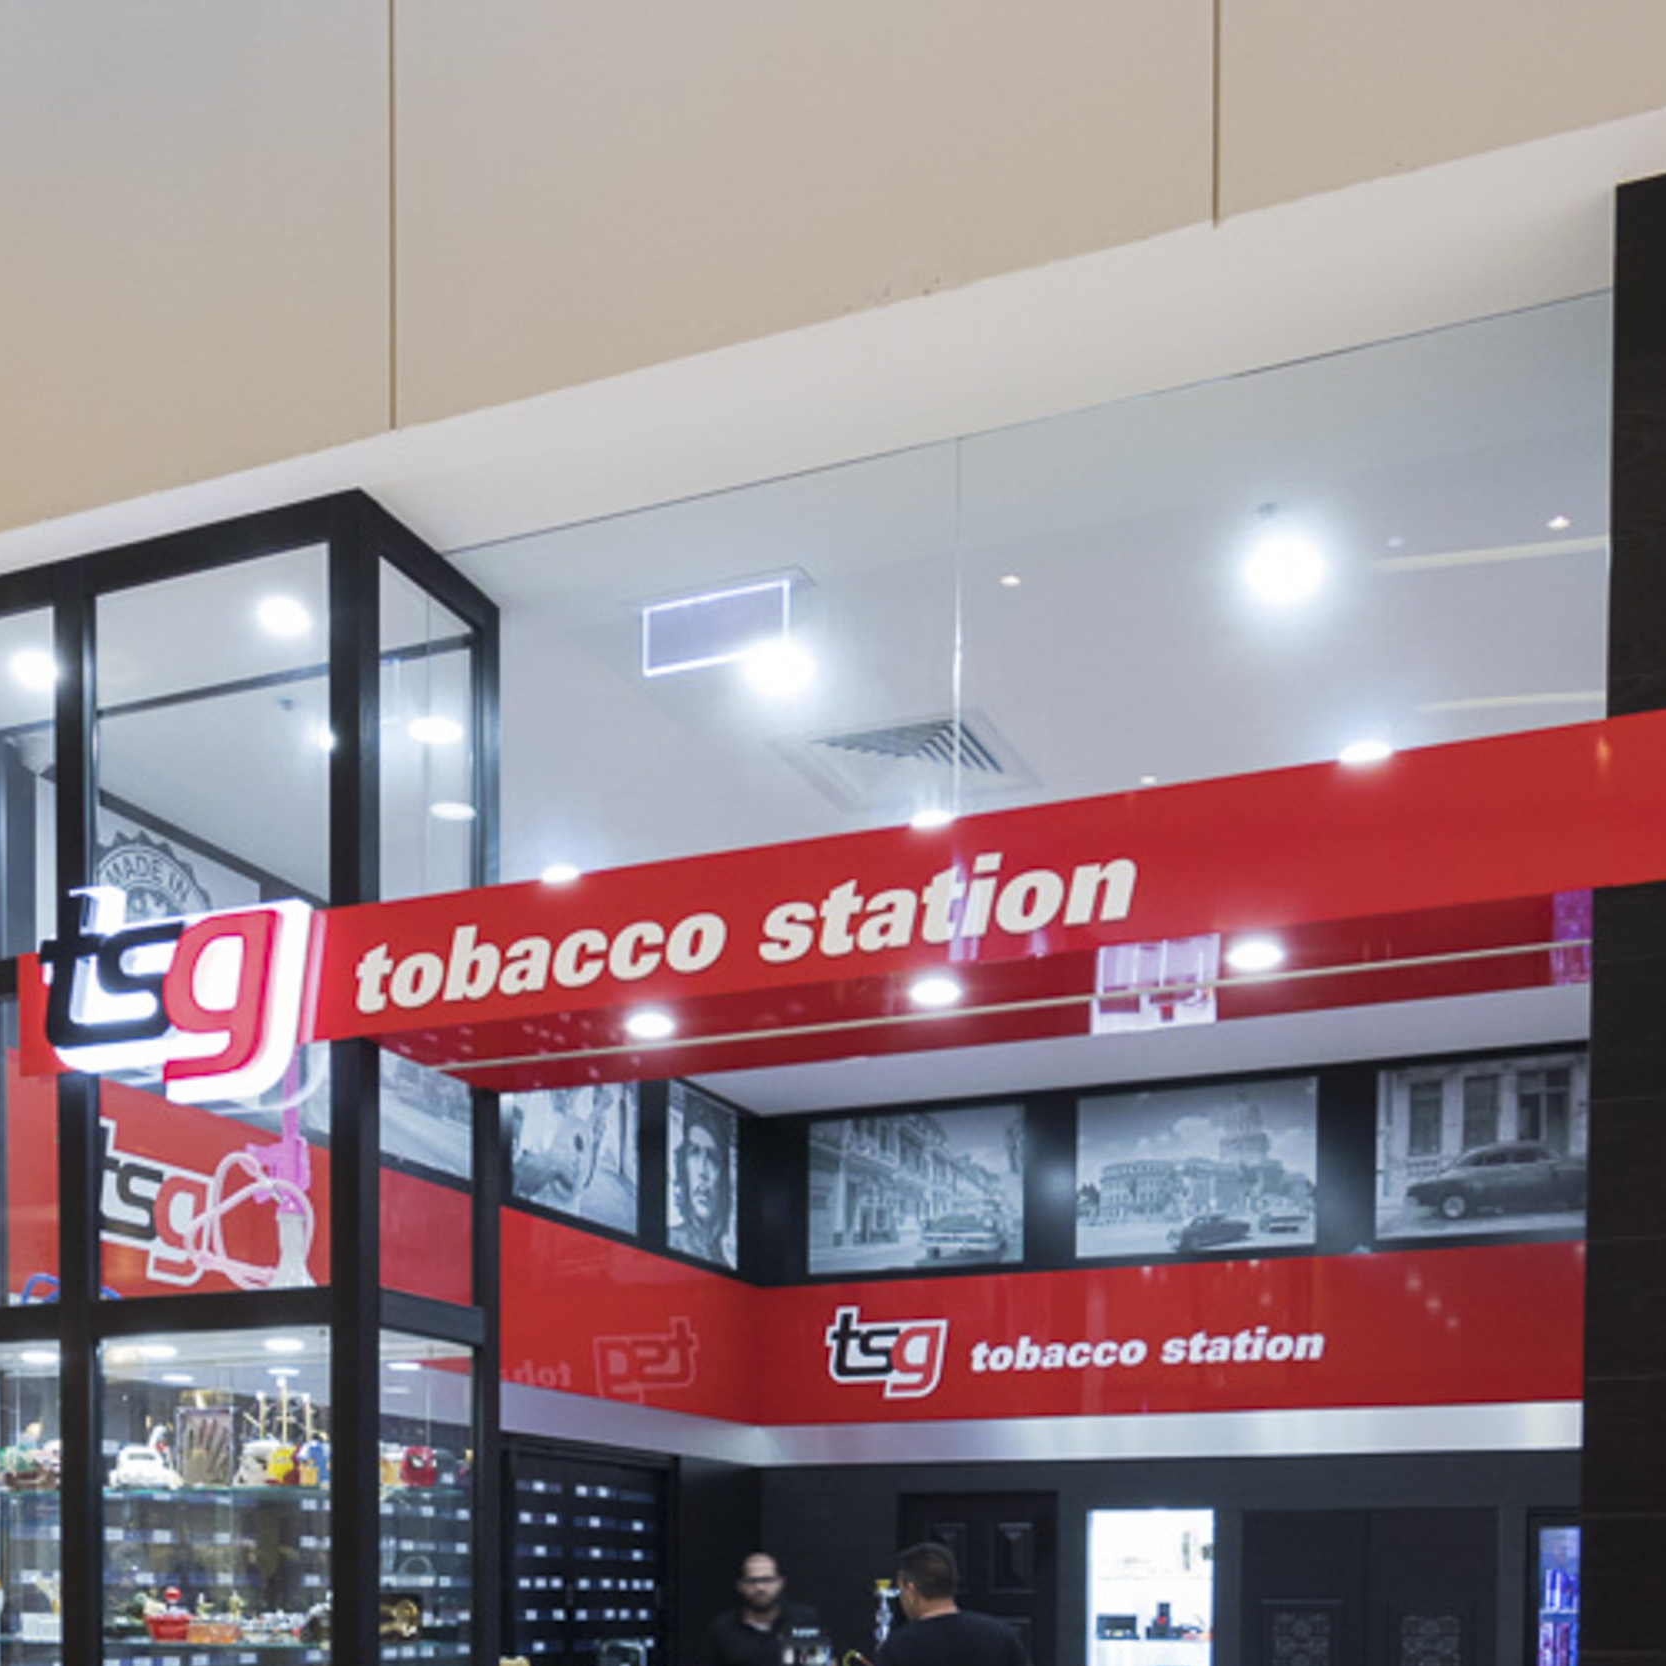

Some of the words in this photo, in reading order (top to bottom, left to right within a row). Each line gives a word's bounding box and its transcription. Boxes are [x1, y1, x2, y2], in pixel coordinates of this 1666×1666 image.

[38, 888, 303, 1100] tsg
[354, 909, 728, 1013] tobacco
[758, 853, 1137, 962] station
[826, 1308, 946, 1398] tsg
[971, 1336, 1148, 1372] tobacco
[1160, 1326, 1325, 1364] station
